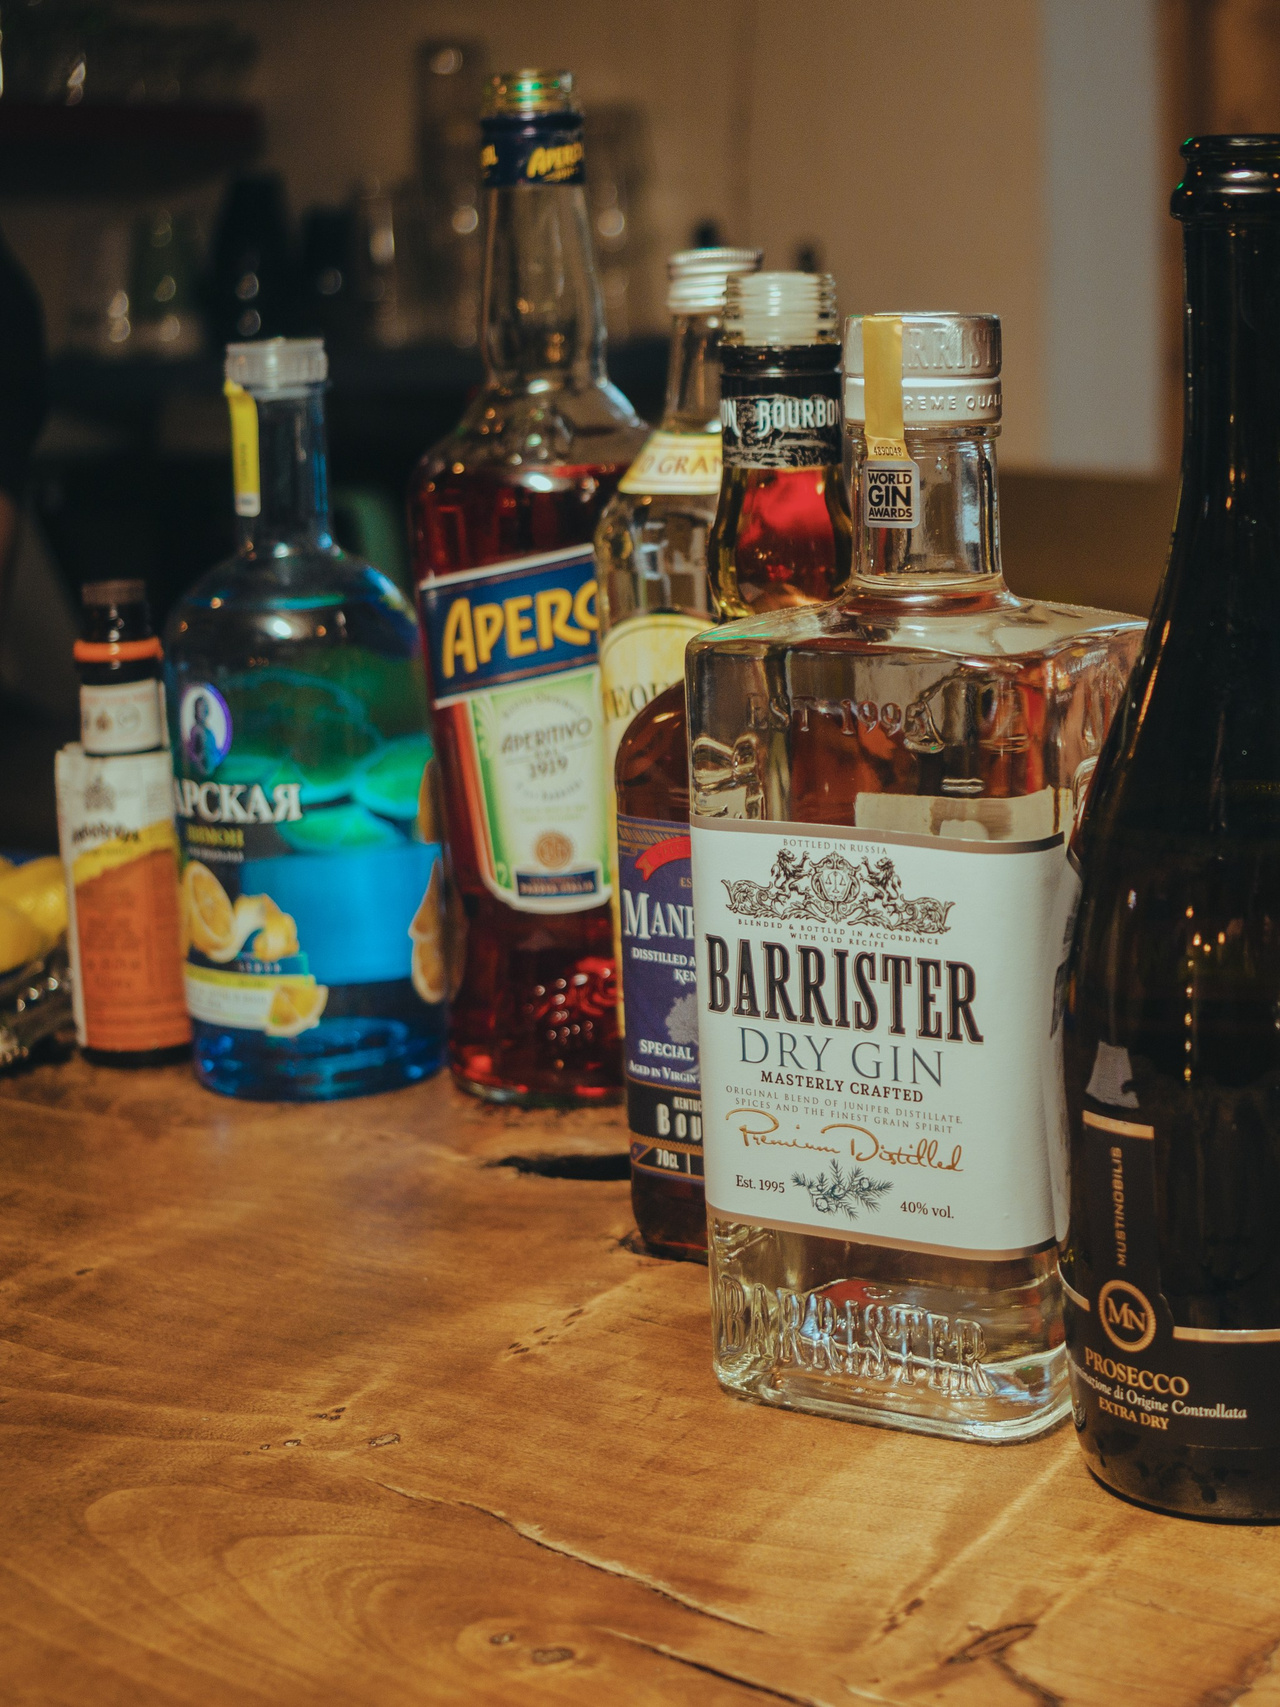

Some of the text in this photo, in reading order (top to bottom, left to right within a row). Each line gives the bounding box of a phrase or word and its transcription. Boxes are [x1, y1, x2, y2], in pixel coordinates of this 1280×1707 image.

[868, 473, 912, 484] WORLD
[868, 485, 911, 507] GIN
[868, 507, 912, 518] AWARDS
[501, 717, 593, 755] APERITIVO
[783, 838, 888, 855] BOTTLED IN RUSSIA
[738, 918, 783, 930] BLENDED
[801, 925, 846, 935] BOTTLED
[869, 932, 939, 945] ACCORDANCE
[790, 932, 885, 948] WITH OLD RECIPE
[705, 933, 985, 1045] BARRISTER
[638, 1038, 695, 1061] SPECIAL
[738, 1026, 944, 1088] DRY GIN
[651, 1067, 661, 1078] IN
[661, 1066, 697, 1083] VIRGIN
[760, 1070, 924, 1103] MASTERLY CRAFTED
[726, 1085, 779, 1100] ORIGINAL
[784, 1093, 820, 1105] BLEND
[825, 1098, 838, 1107] OF
[843, 1101, 890, 1115] JUNIPER
[735, 1097, 953, 1134] SPICES AND THE FINEST GRAIN SPIRIT
[725, 1107, 964, 1172] Premium Distilled
[735, 1173, 785, 1194] Est. 1995
[900, 1201, 955, 1220] 40% vol.
[1109, 1146, 1128, 1268] MUSTINOBILIS
[1107, 1297, 1146, 1333] MN
[1085, 1346, 1190, 1397] PROSECCO
[1098, 1396, 1170, 1430] EXTRA DRY
[1113, 1384, 1124, 1400] di
[1126, 1389, 1169, 1412] Origine
[1171, 1399, 1248, 1419] Controllata
